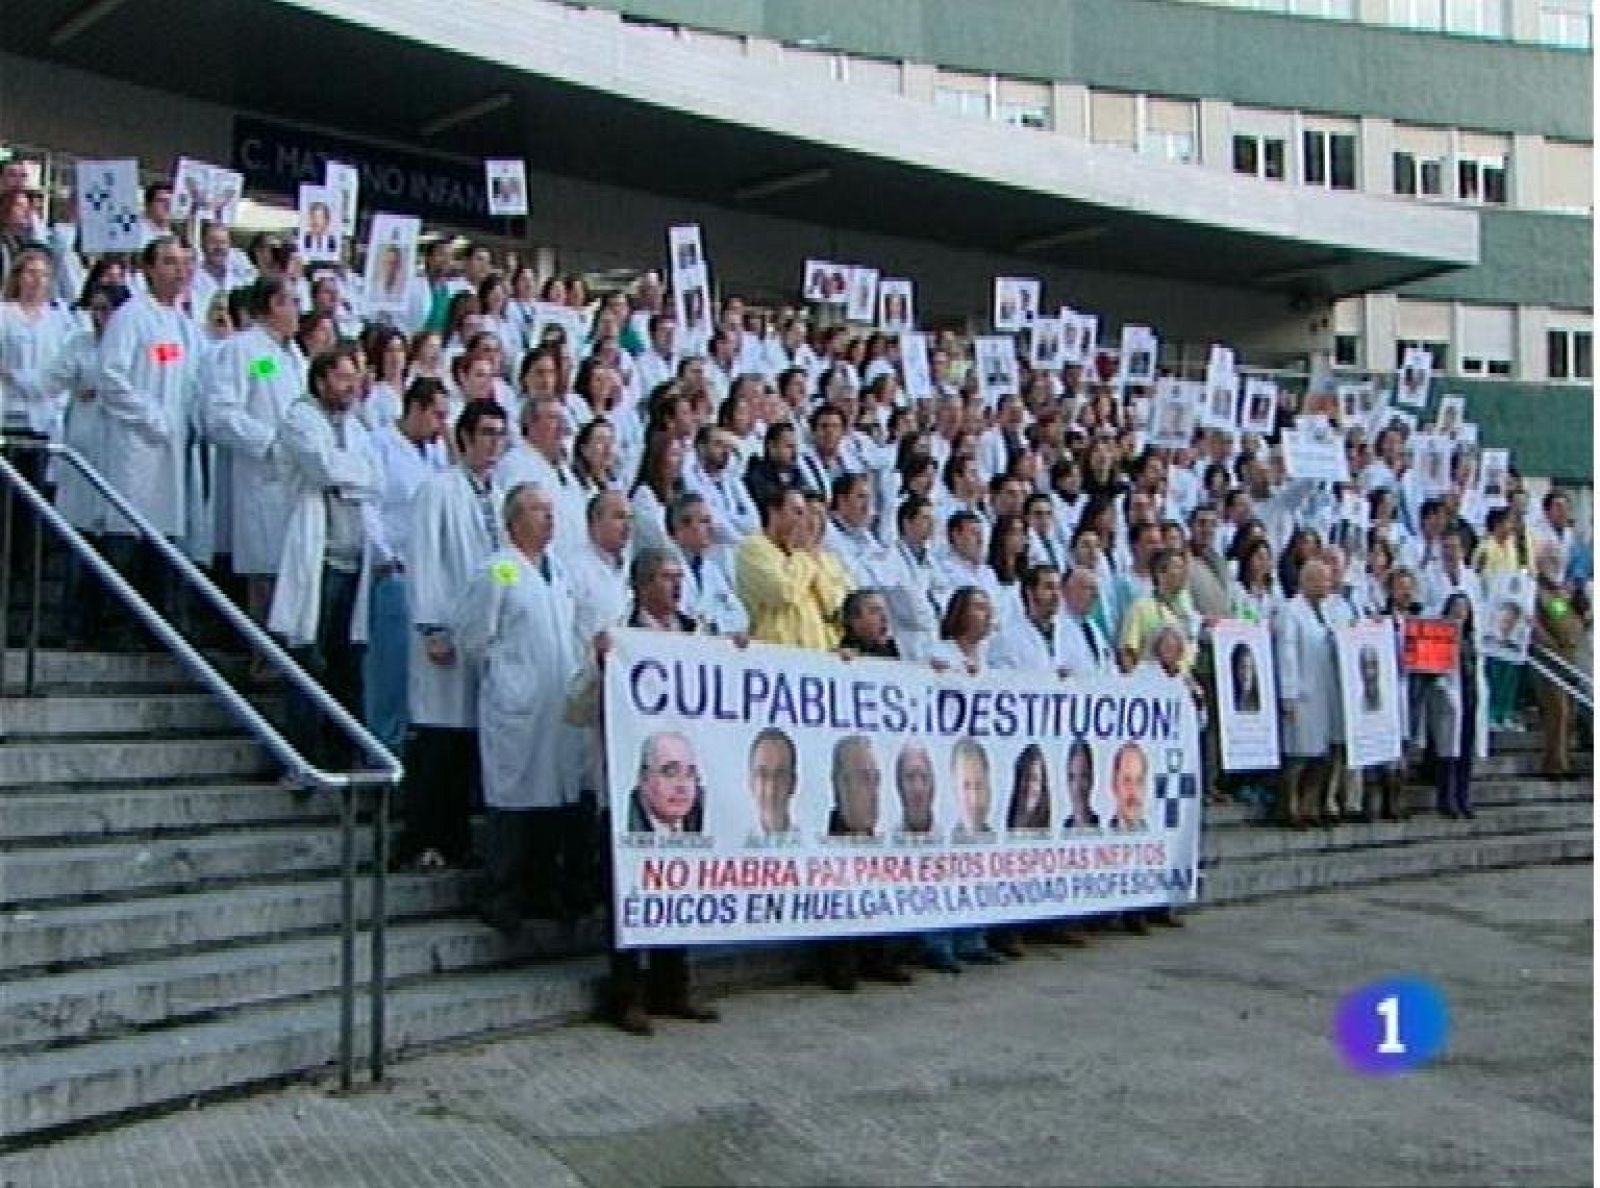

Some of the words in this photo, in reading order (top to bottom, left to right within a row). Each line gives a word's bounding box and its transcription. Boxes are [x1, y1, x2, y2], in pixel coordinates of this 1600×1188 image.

[642, 857, 691, 890] NO
[699, 855, 800, 888] HABRA
[853, 855, 914, 884] PARA
[919, 851, 985, 882] ESTOS
[989, 847, 1091, 878] DESPOTAS
[1094, 842, 1167, 868] INEPTOS
[745, 893, 784, 924] EN
[793, 888, 895, 920] HUELGA
[896, 883, 942, 915] POR
[946, 882, 975, 911] LA
[975, 875, 1068, 907] DIGNIDAD
